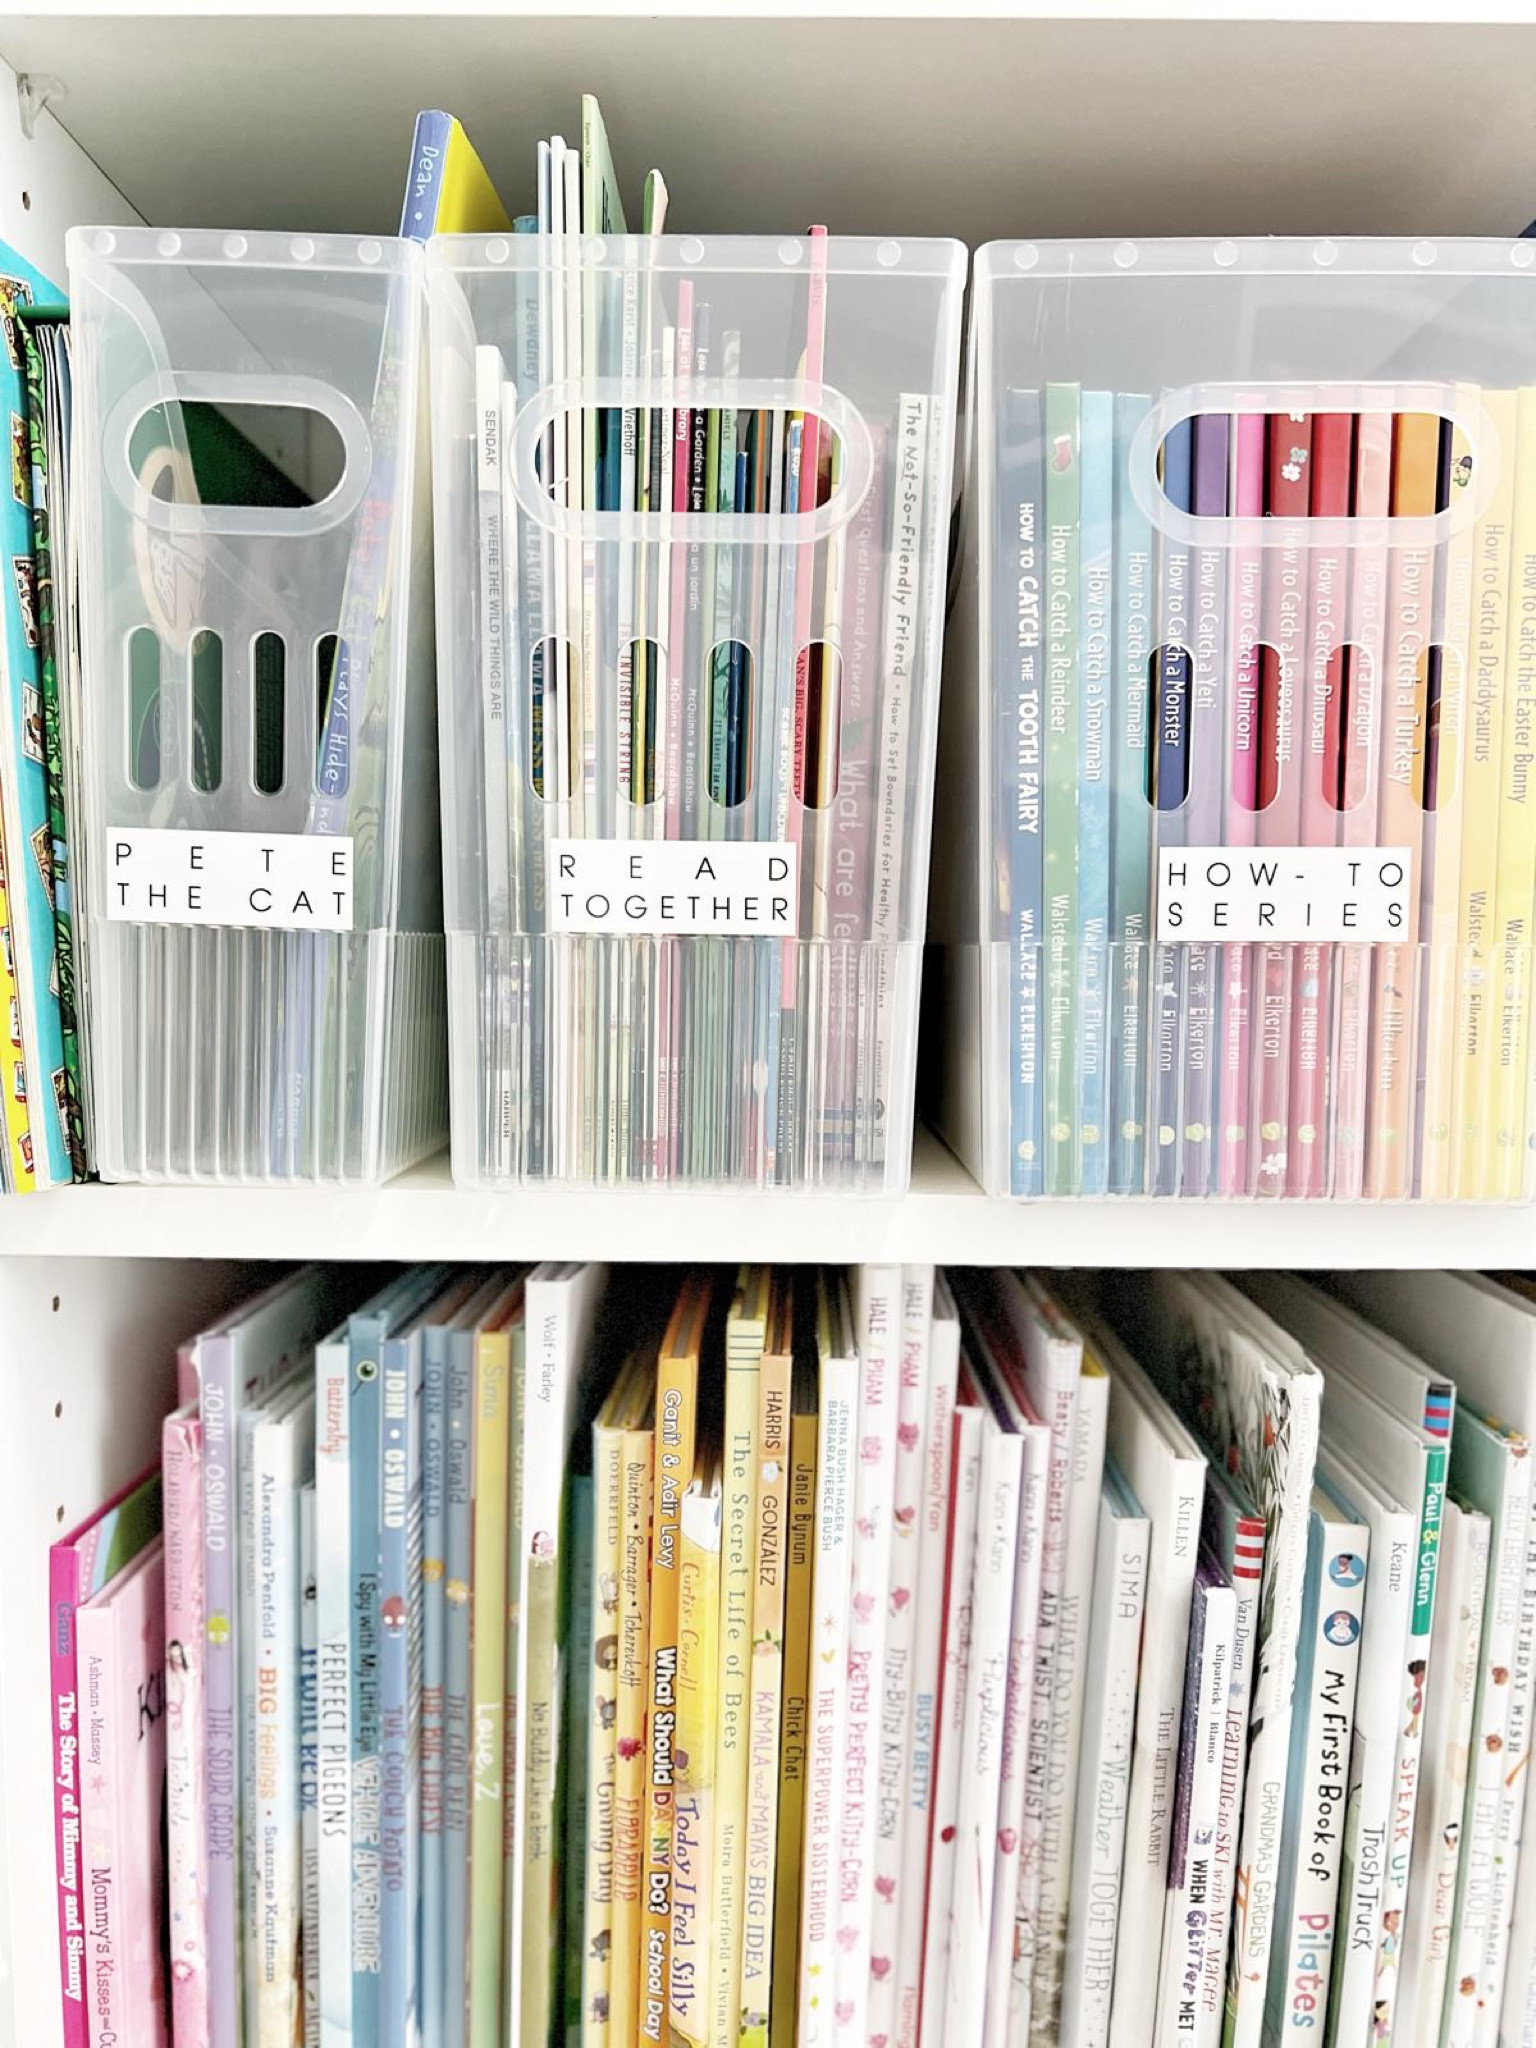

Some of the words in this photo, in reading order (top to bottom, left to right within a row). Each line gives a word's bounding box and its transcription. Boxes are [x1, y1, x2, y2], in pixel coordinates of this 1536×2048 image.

[415, 146, 439, 197] Dean
[523, 298, 541, 381] Dewdney
[486, 410, 497, 465] SENDAK
[906, 402, 922, 437] The
[488, 515, 500, 565] WHERE
[891, 446, 919, 605] Not-So-Friendly
[1019, 503, 1034, 541] HOW
[1051, 525, 1072, 561] How
[1484, 524, 1506, 561] How
[489, 570, 499, 596] THE
[1019, 547, 1034, 568] TO
[1052, 566, 1069, 585] to
[1398, 550, 1422, 596] How
[1483, 567, 1501, 585] to
[1018, 576, 1039, 648] CATCH
[1087, 567, 1108, 605] How
[489, 600, 500, 633] WILD
[1051, 590, 1072, 637] Catch
[1087, 611, 1104, 629] to
[1398, 606, 1418, 627] to
[1480, 589, 1503, 636] Catch
[490, 637, 501, 689] THINGS
[892, 614, 911, 676] Friend
[1020, 655, 1034, 682] THE
[1052, 642, 1066, 652] a
[1086, 633, 1108, 680] Catch
[1397, 631, 1422, 689] Catch
[1479, 640, 1493, 651] a
[491, 692, 502, 720] ARE
[619, 656, 631, 724] INVISIBLE
[890, 697, 902, 726] How
[1051, 657, 1072, 734] Reindeer
[1086, 684, 1101, 694] a
[1396, 695, 1411, 707] a
[1472, 655, 1501, 763] Daddysaurus
[888, 731, 900, 744] to
[1018, 690, 1039, 765] TOOTH
[1085, 699, 1107, 782] Snowman
[1390, 713, 1419, 784] Turkey
[620, 731, 632, 784] STRING
[886, 749, 899, 771] Set
[882, 775, 898, 848] Boundaries
[1018, 772, 1039, 834] FAIRY
[881, 853, 893, 873] for
[1348, 862, 1403, 888] TO
[117, 881, 203, 909] THE
[249, 887, 348, 915] CAT
[559, 891, 789, 922] TOGETHER
[876, 878, 892, 928] Healthy
[204, 1382, 225, 1441] JOHN
[319, 1376, 347, 1455] Battersby
[385, 1369, 406, 1418] JOHN
[662, 1389, 682, 1447] Ganit
[765, 1390, 784, 1449] HARRIS
[825, 1399, 838, 1463] BARBARA
[838, 1399, 850, 1446] JENNA
[661, 1453, 678, 1469] &
[732, 1431, 752, 1479] The
[836, 1448, 848, 1485] BUSH
[205, 1463, 225, 1551] OSWALD
[384, 1448, 406, 1528] OSWALD
[660, 1474, 679, 1518] Adir
[795, 1463, 813, 1506] Janie
[823, 1466, 836, 1512] PIERCE
[835, 1487, 847, 1534] HAGER
[1425, 1481, 1444, 1523] Paul
[259, 1473, 275, 1567] Alexandra
[730, 1494, 750, 1575] Secret
[759, 1495, 784, 1586] GONZÁLEZ
[791, 1513, 812, 1565] Bynum
[822, 1516, 834, 1551] BUSH
[833, 1536, 844, 1545] &
[1172, 1495, 1195, 1558] KILLEN
[1422, 1529, 1440, 1545] &
[655, 1524, 677, 1570] Levy
[1387, 1541, 1408, 1593] Keane
[681, 1562, 700, 1624] Curtis
[1117, 1553, 1141, 1620] SIMA
[1415, 1551, 1437, 1606] Glenn
[57, 1602, 73, 1656] Ganz
[260, 1572, 276, 1639] Penfold
[728, 1591, 747, 1639] Life
[88, 1655, 102, 1708] Ashman
[653, 1646, 678, 1705] What
[676, 1629, 699, 1691] Cornell
[725, 1654, 745, 1676] of
[59, 1692, 76, 1730] The
[259, 1668, 277, 1715] BIG
[321, 1643, 347, 1731] PERFECT
[817, 1688, 835, 1718] THE
[1320, 1669, 1347, 1705] My
[88, 1718, 104, 1765] Massey
[207, 1707, 234, 1738] THE
[383, 1705, 404, 1738] THE
[723, 1693, 742, 1750] Bees
[753, 1691, 775, 1767] KAMALA
[785, 1696, 806, 1738] Chick
[1157, 1707, 1177, 1743] THE
[57, 1735, 78, 1790] Story
[258, 1722, 278, 1800] Feelings
[652, 1710, 675, 1786] Should
[783, 1745, 805, 1781] Chat
[1319, 1712, 1348, 1776] First
[207, 1746, 233, 1796] SOUR
[321, 1744, 347, 1838] PIGEONS
[382, 1750, 406, 1817] COUCH
[753, 1771, 770, 1803] and
[812, 1725, 834, 1836] SUPERPOWER
[1150, 1746, 1174, 1803] LITTLE
[62, 1793, 79, 1814] of
[1095, 1758, 1129, 1858] Weather
[1312, 1784, 1342, 1844] Book
[1392, 1757, 1417, 1843] SPEAK
[207, 1801, 234, 1861] GRAPE
[651, 1790, 673, 1866] DANNY
[673, 1798, 700, 1874] Today
[720, 1823, 736, 1868] Moira
[749, 1805, 771, 1869] MAYA'S
[1145, 1809, 1168, 1867] RABBIT
[1254, 1781, 1283, 1873] GRANDMAS
[1356, 1822, 1386, 1884] Trash
[61, 1817, 81, 1890] Mimmy
[263, 1825, 279, 1898] Suzanne
[381, 1827, 405, 1893] POTATO
[1308, 1852, 1332, 1881] of
[1391, 1853, 1410, 1889] UP
[66, 1894, 82, 1931] and
[90, 1868, 112, 1953] Mommy's
[648, 1872, 670, 1915] Do?
[676, 1881, 698, 1893] I
[746, 1874, 767, 1920] BIG
[808, 1842, 830, 1943] SISTERHOOD
[674, 1900, 697, 1947] Feel
[717, 1875, 734, 1960] Butterfield
[1085, 1867, 1120, 1990] TOGETHER
[1247, 1880, 1273, 1958] GARDENS
[1352, 1890, 1378, 1951] Truck
[62, 1936, 84, 2002] Simmy
[263, 1904, 279, 1984] Kaufman
[646, 1927, 669, 1997] School
[743, 1924, 766, 1980] IDEA
[96, 1959, 114, 2016] Kisses
[670, 1962, 697, 2017] Silly
[1291, 1913, 1332, 2028] Pilates
[642, 2000, 665, 2041] Day
[716, 1981, 731, 2031] Vivian
